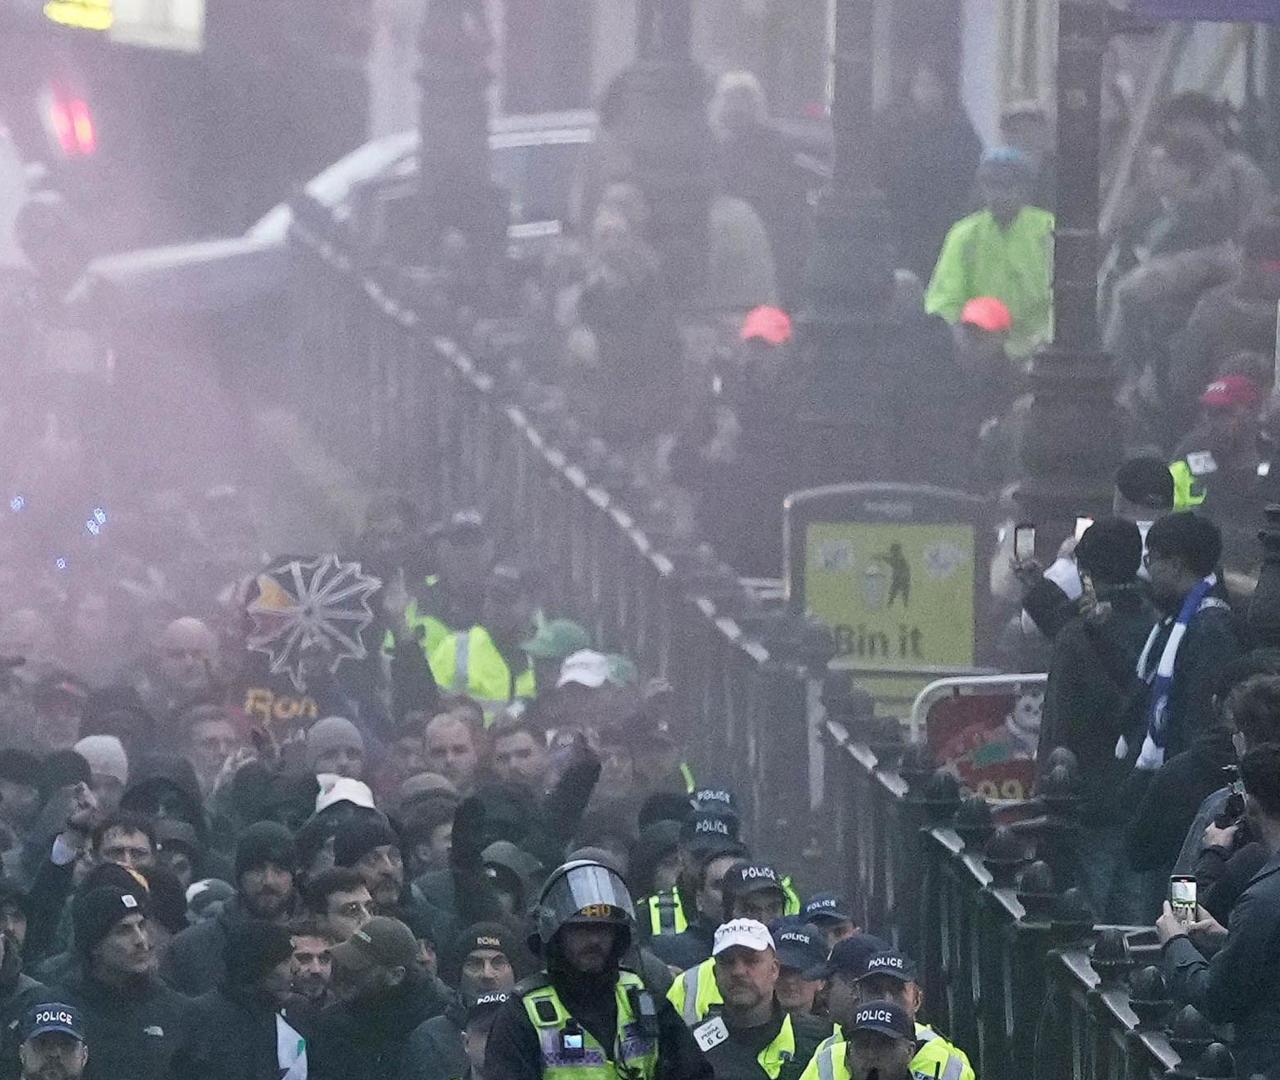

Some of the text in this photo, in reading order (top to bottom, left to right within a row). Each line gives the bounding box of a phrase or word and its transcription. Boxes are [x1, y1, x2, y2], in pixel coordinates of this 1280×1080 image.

[696, 789, 731, 804] POLICE
[696, 819, 729, 835] POLICE
[741, 866, 776, 881] POLICE
[806, 899, 836, 912] POLICE
[780, 931, 810, 945] POLICE
[868, 957, 903, 969] POLICE
[36, 1011, 73, 1026] POLICE
[856, 1010, 893, 1024] POLICE
